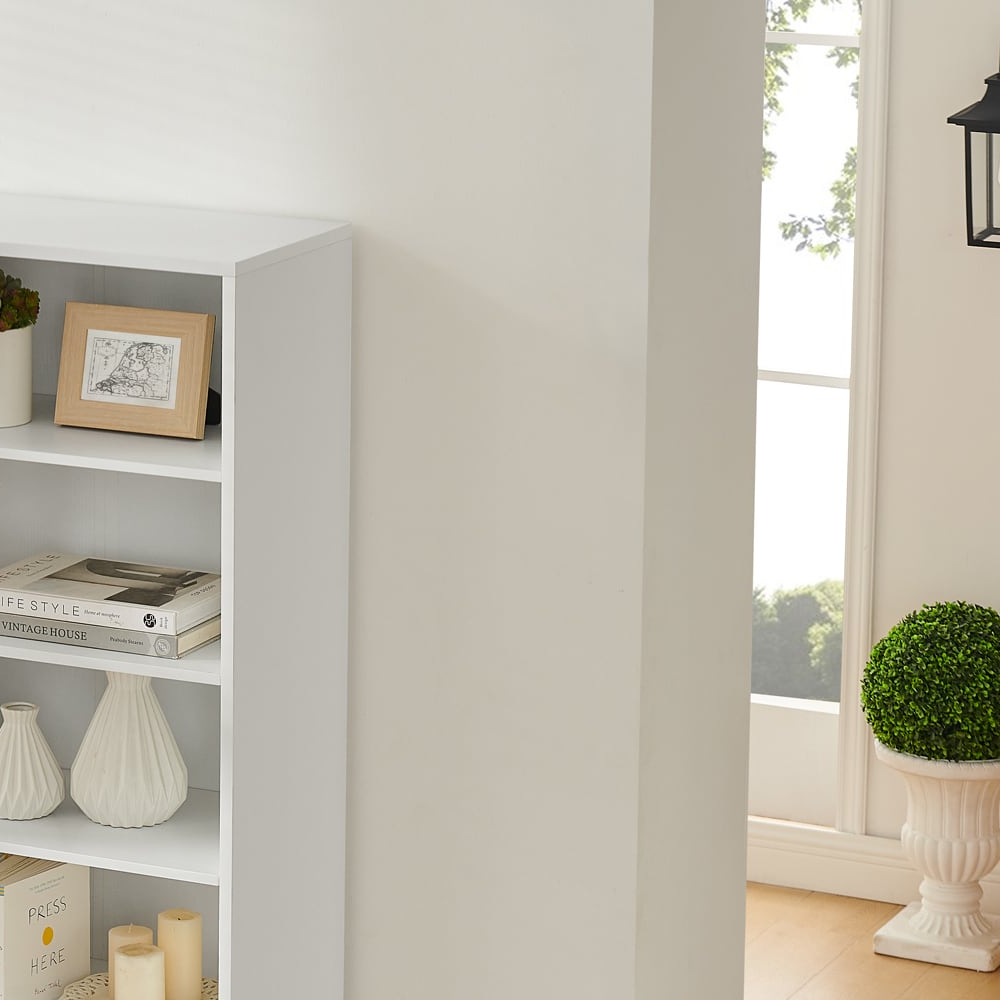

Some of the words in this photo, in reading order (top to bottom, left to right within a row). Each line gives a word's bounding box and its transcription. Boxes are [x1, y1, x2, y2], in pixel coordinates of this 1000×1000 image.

[2, 621, 48, 636] VINTAGE
[50, 628, 87, 640] HOUSE
[28, 896, 66, 925] PRESS
[31, 948, 65, 976] HERE
